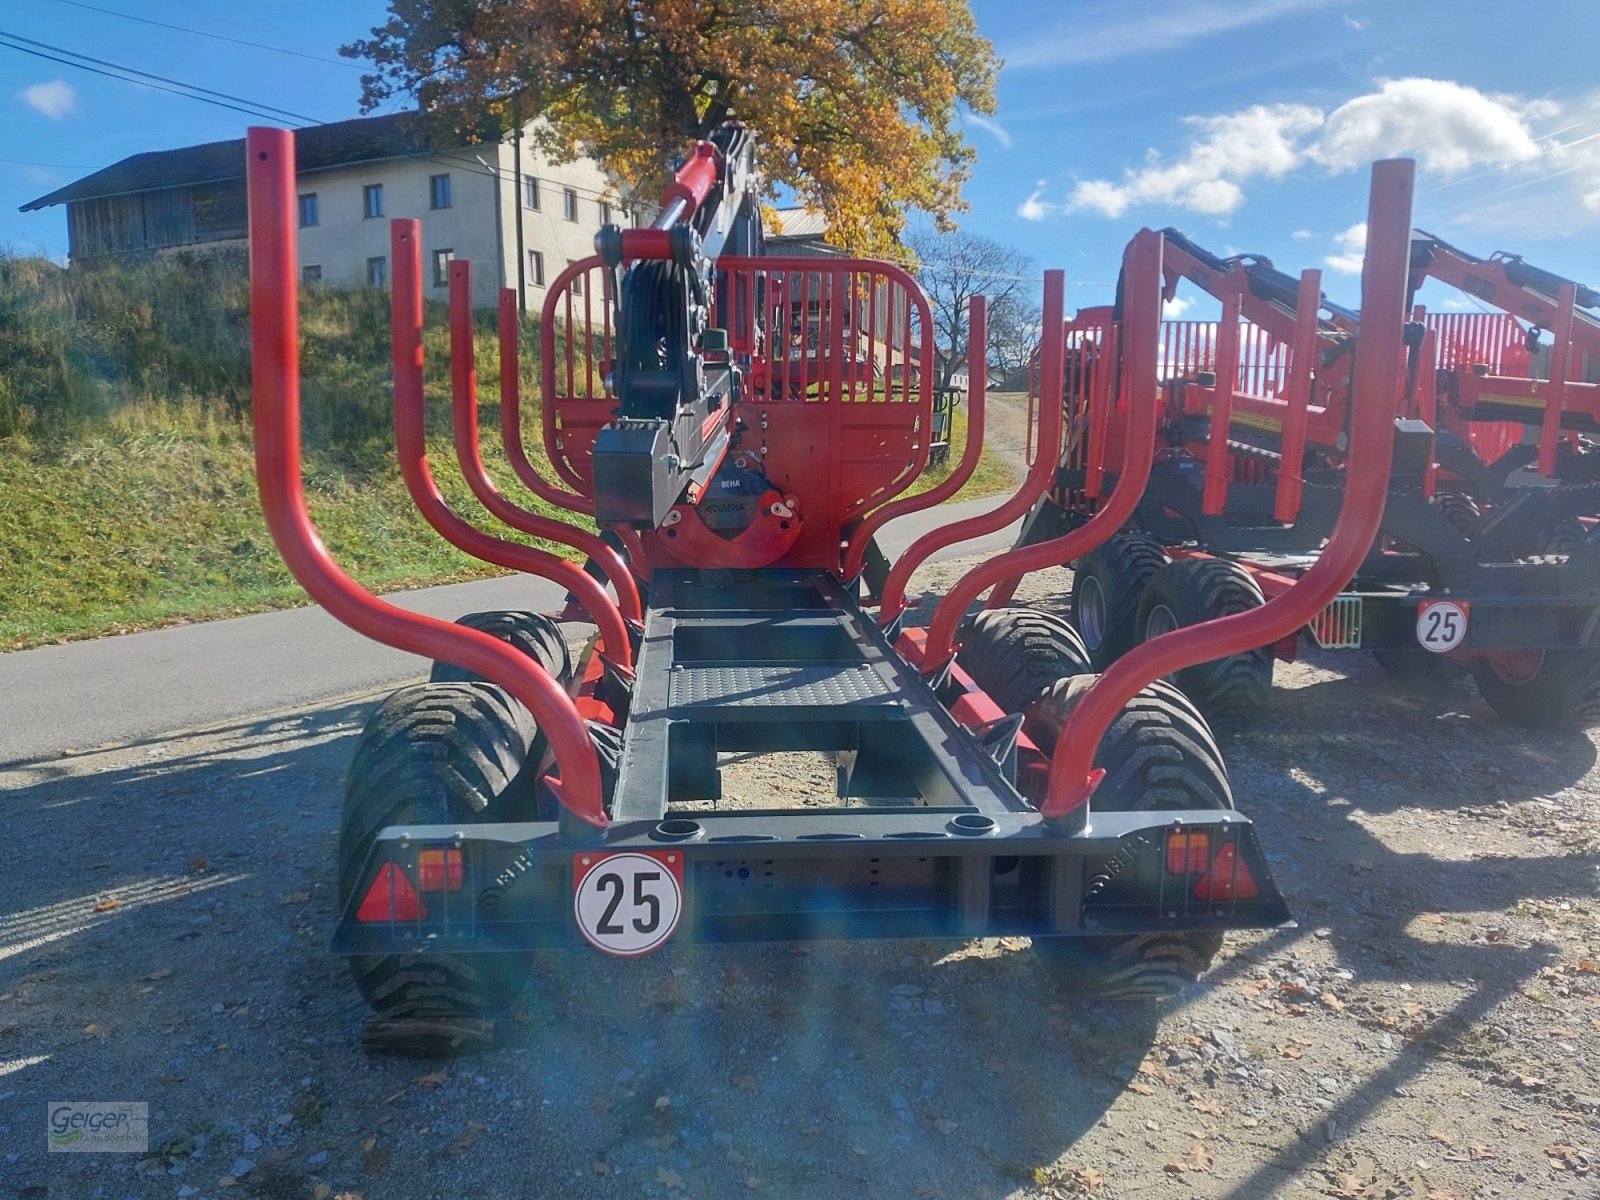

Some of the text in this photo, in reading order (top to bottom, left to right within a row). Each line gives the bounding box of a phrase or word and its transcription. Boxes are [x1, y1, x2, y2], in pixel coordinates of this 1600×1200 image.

[720, 479, 741, 489] BEHA
[720, 503, 746, 513] BEHA
[1425, 611, 1459, 643] 25
[596, 872, 661, 935] 25
